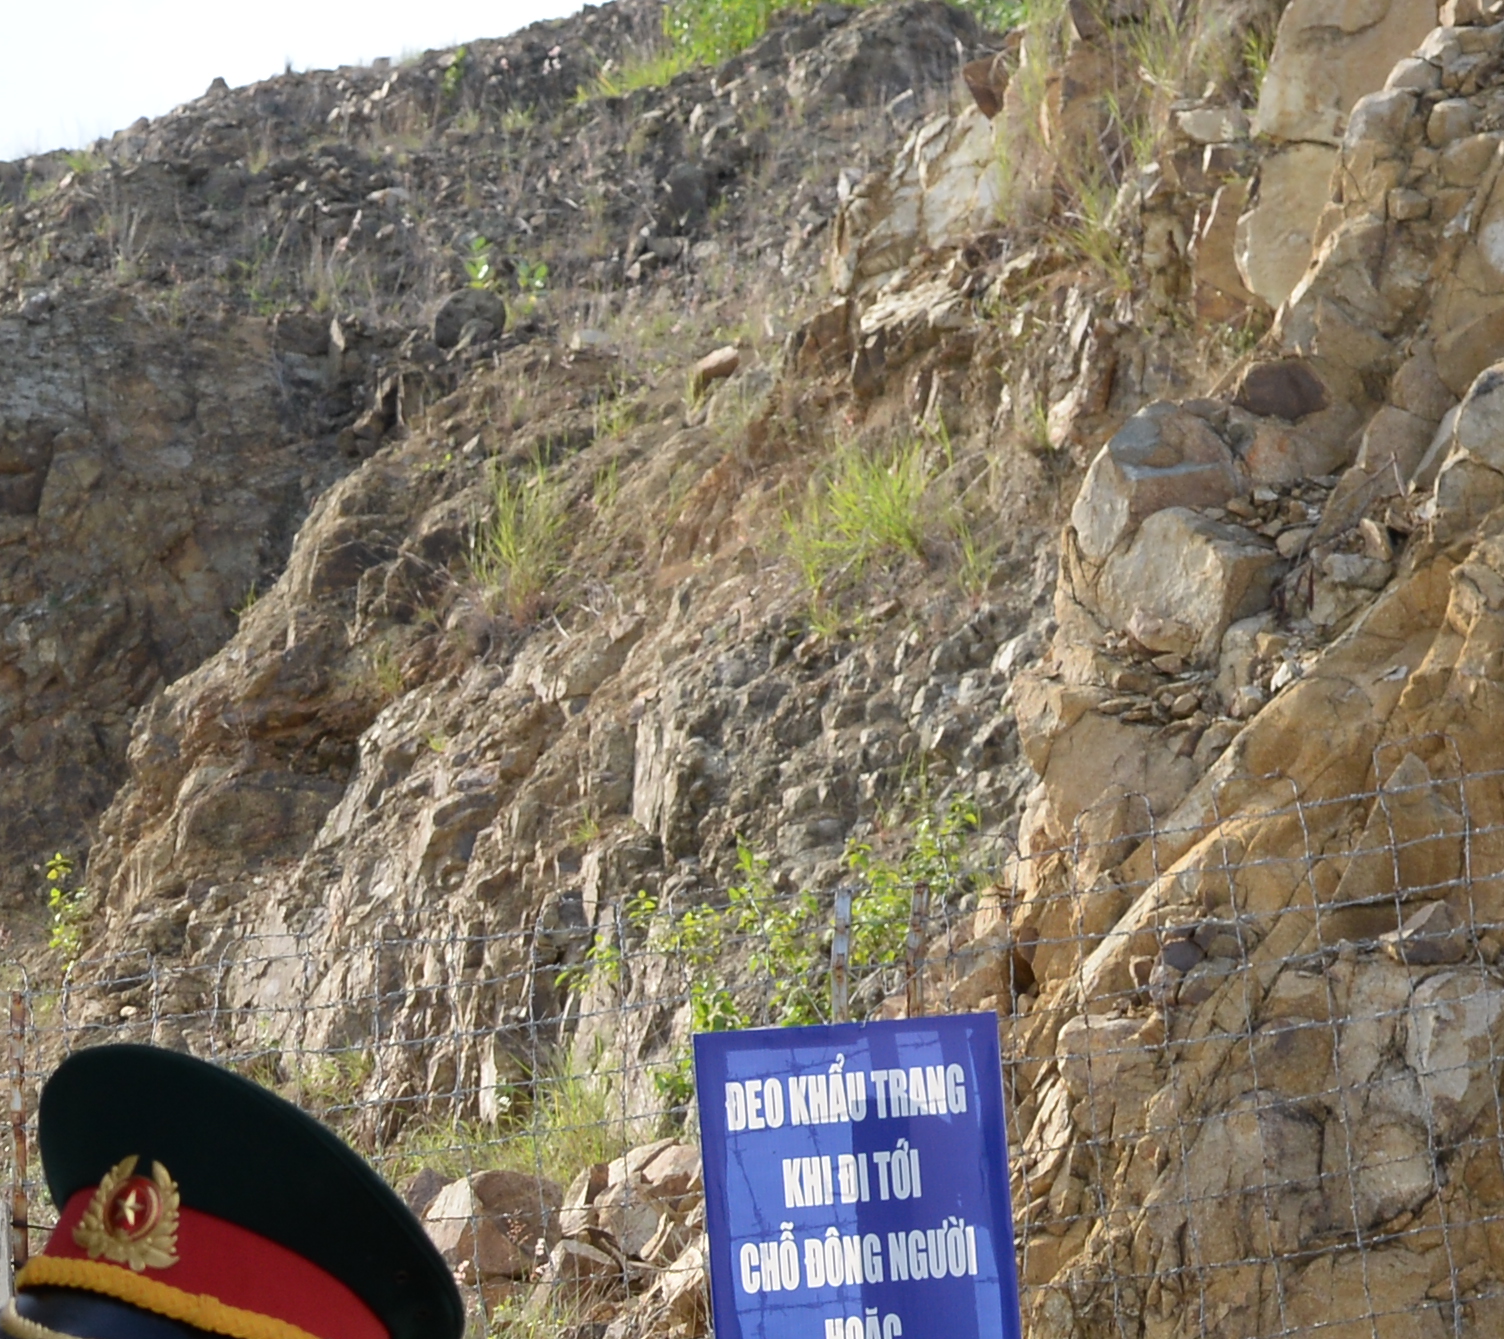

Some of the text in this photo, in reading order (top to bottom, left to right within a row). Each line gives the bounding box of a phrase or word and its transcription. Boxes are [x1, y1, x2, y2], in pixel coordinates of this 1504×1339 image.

[725, 1053, 967, 1131] ĐEO KHẨU TRANG
[782, 1138, 922, 1208] KHI ĐI TỚI
[740, 1216, 978, 1294] CHỖ ĐÔNG NGƯỜI
